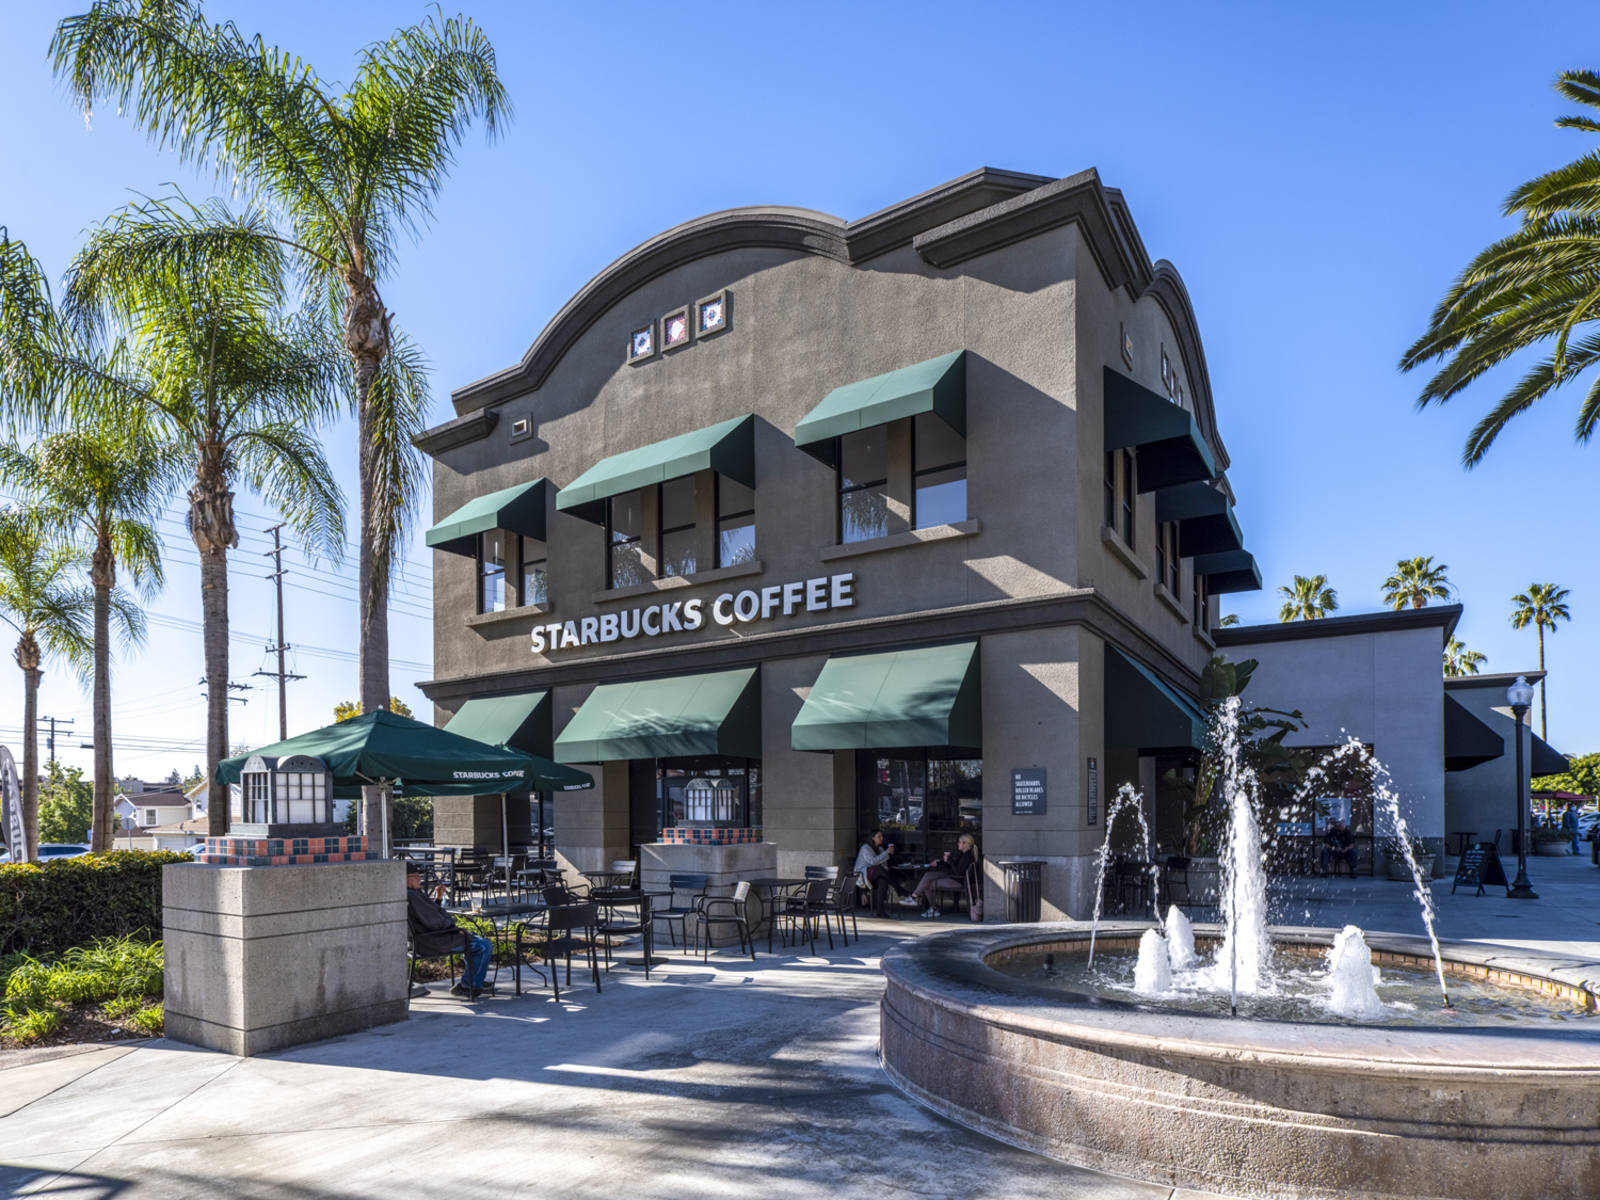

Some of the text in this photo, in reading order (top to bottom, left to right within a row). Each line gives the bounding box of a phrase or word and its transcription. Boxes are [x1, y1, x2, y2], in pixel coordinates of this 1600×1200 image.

[531, 572, 853, 653] STARBUCKS COFFEE
[453, 771, 500, 779] STARBUCKS
